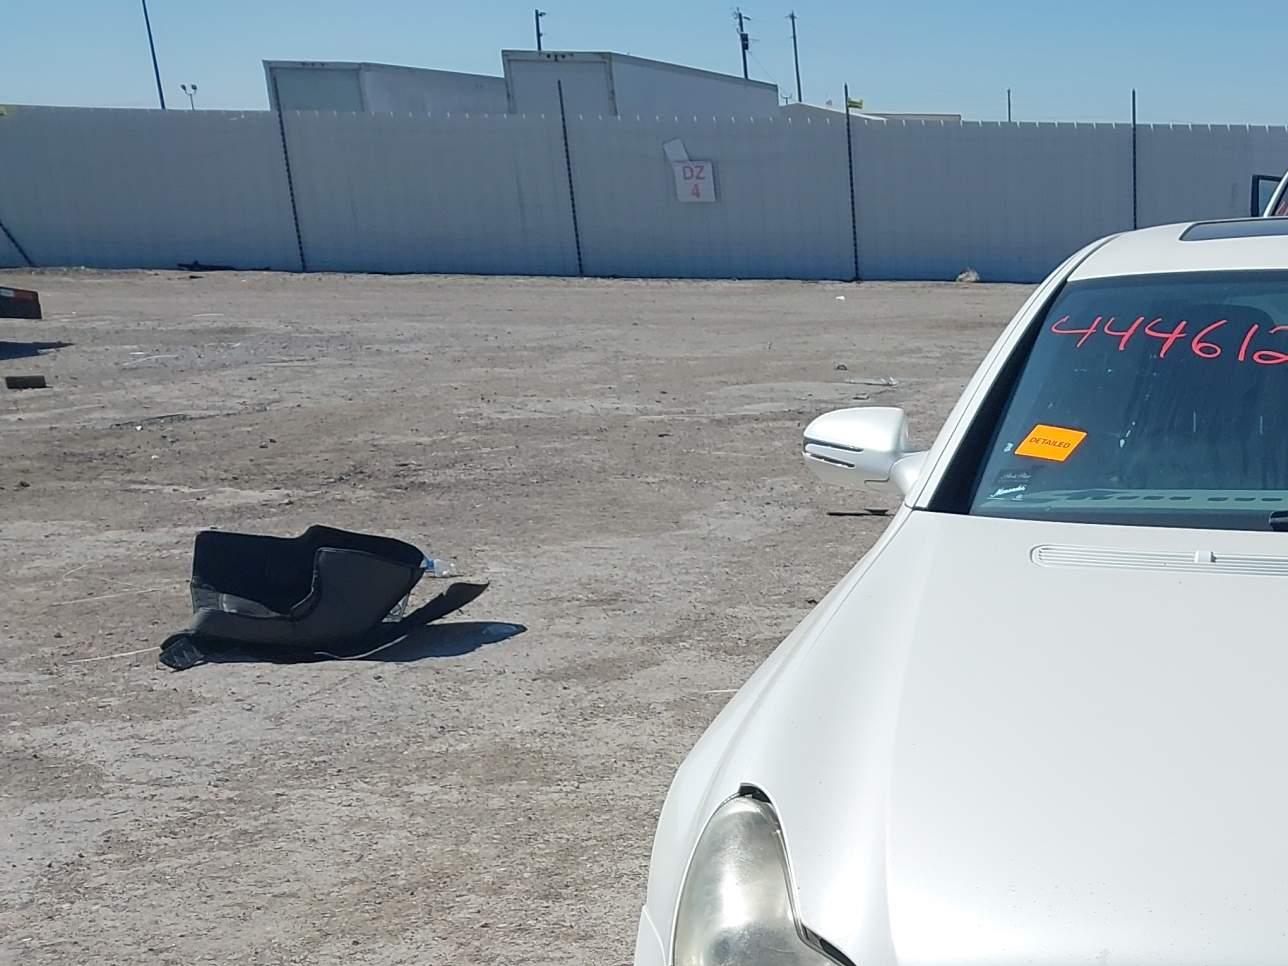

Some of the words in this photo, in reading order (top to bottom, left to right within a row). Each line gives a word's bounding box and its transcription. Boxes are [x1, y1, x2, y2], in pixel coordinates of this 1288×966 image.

[682, 165, 705, 180] DZ
[691, 183, 700, 199] 4
[1029, 436, 1072, 449] DETAILED
